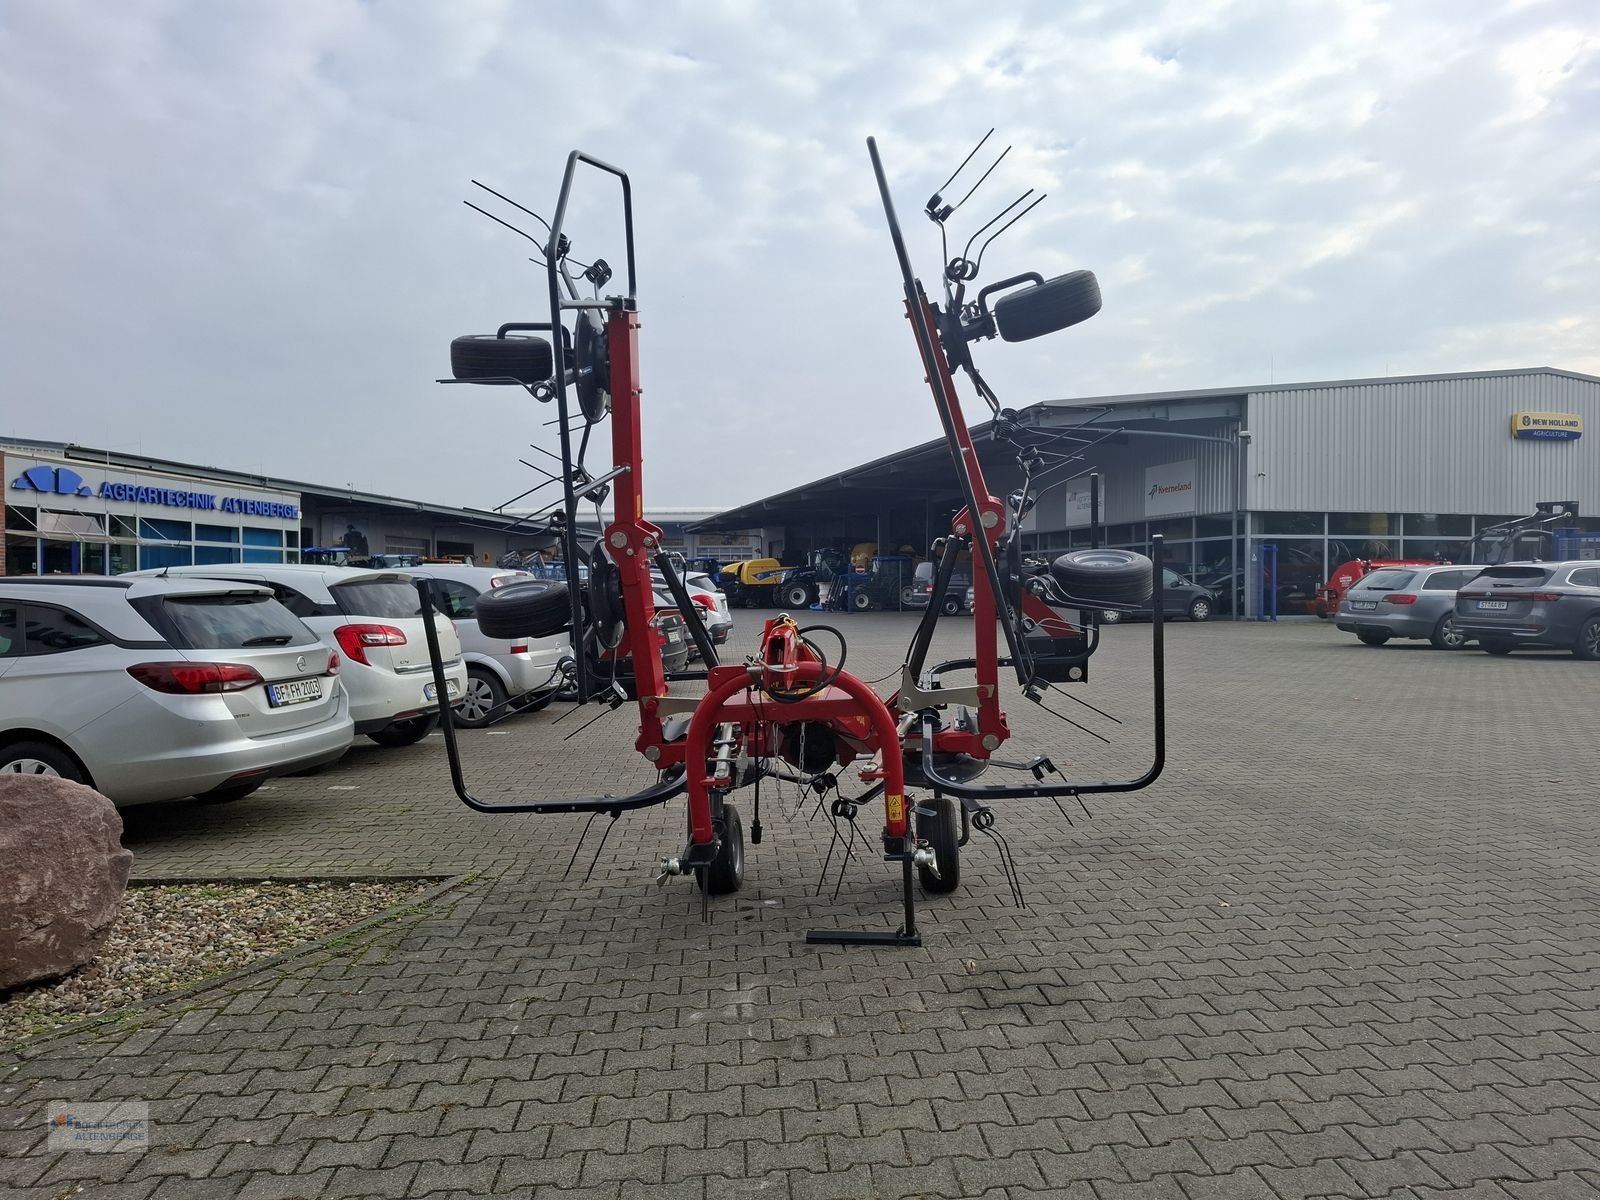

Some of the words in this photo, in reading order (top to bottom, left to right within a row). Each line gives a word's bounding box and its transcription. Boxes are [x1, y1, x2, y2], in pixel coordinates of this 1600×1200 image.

[1532, 418, 1548, 426] NEW
[1549, 419, 1579, 427] HOLLAND
[1533, 430, 1568, 438] AGRICULTURE
[1158, 481, 1192, 494] Kverneland
[101, 481, 217, 510] AGRARTECHNIK
[222, 497, 299, 519] ALTENBERGE
[275, 686, 286, 700] BF
[290, 683, 301, 697] FH
[301, 680, 320, 696] 2003
